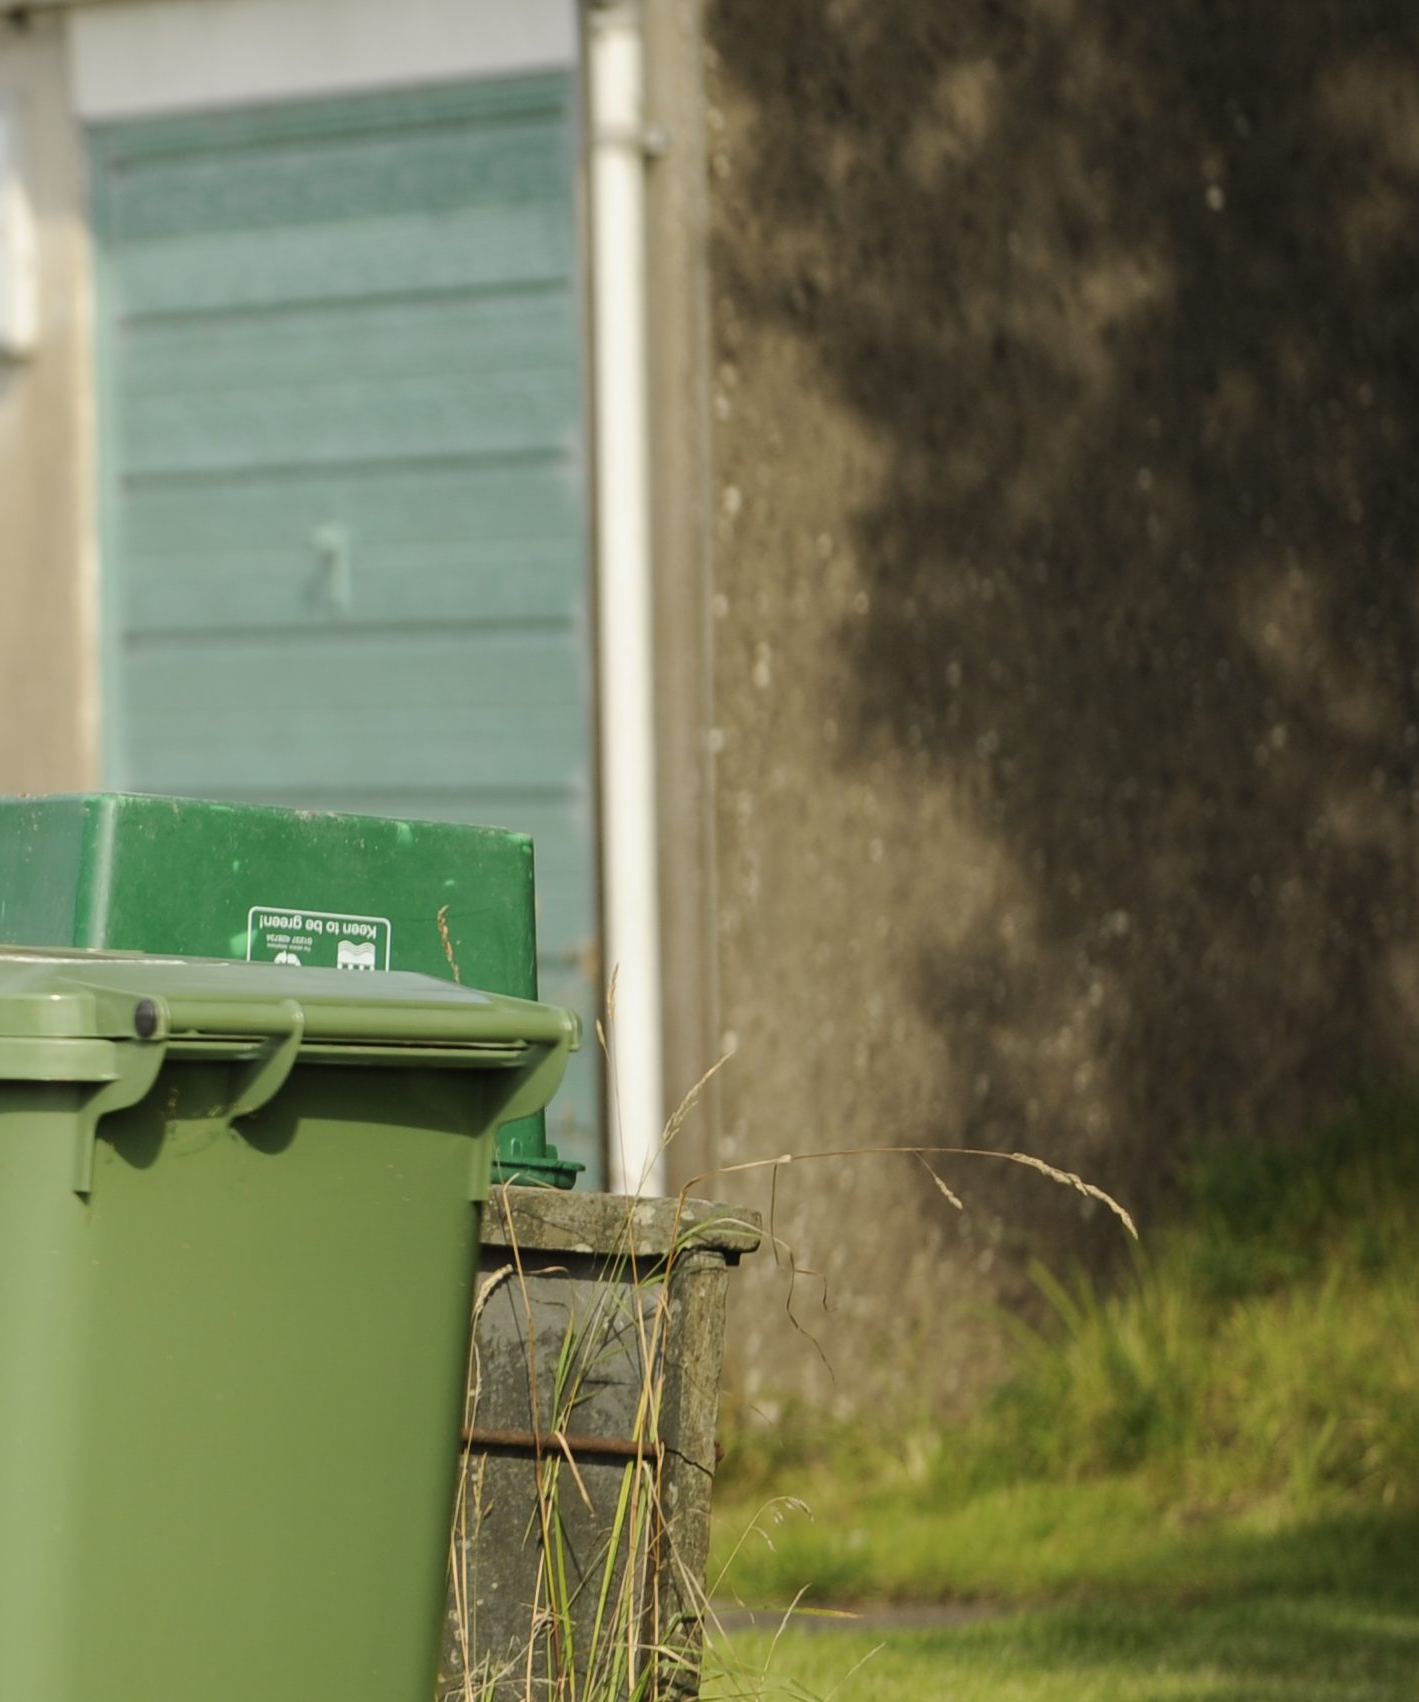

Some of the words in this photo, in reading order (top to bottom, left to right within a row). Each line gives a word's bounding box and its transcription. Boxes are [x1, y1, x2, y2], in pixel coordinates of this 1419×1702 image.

[259, 915, 302, 930] green!
[305, 920, 322, 934] be
[326, 922, 339, 935] to
[343, 925, 377, 939] Keen
